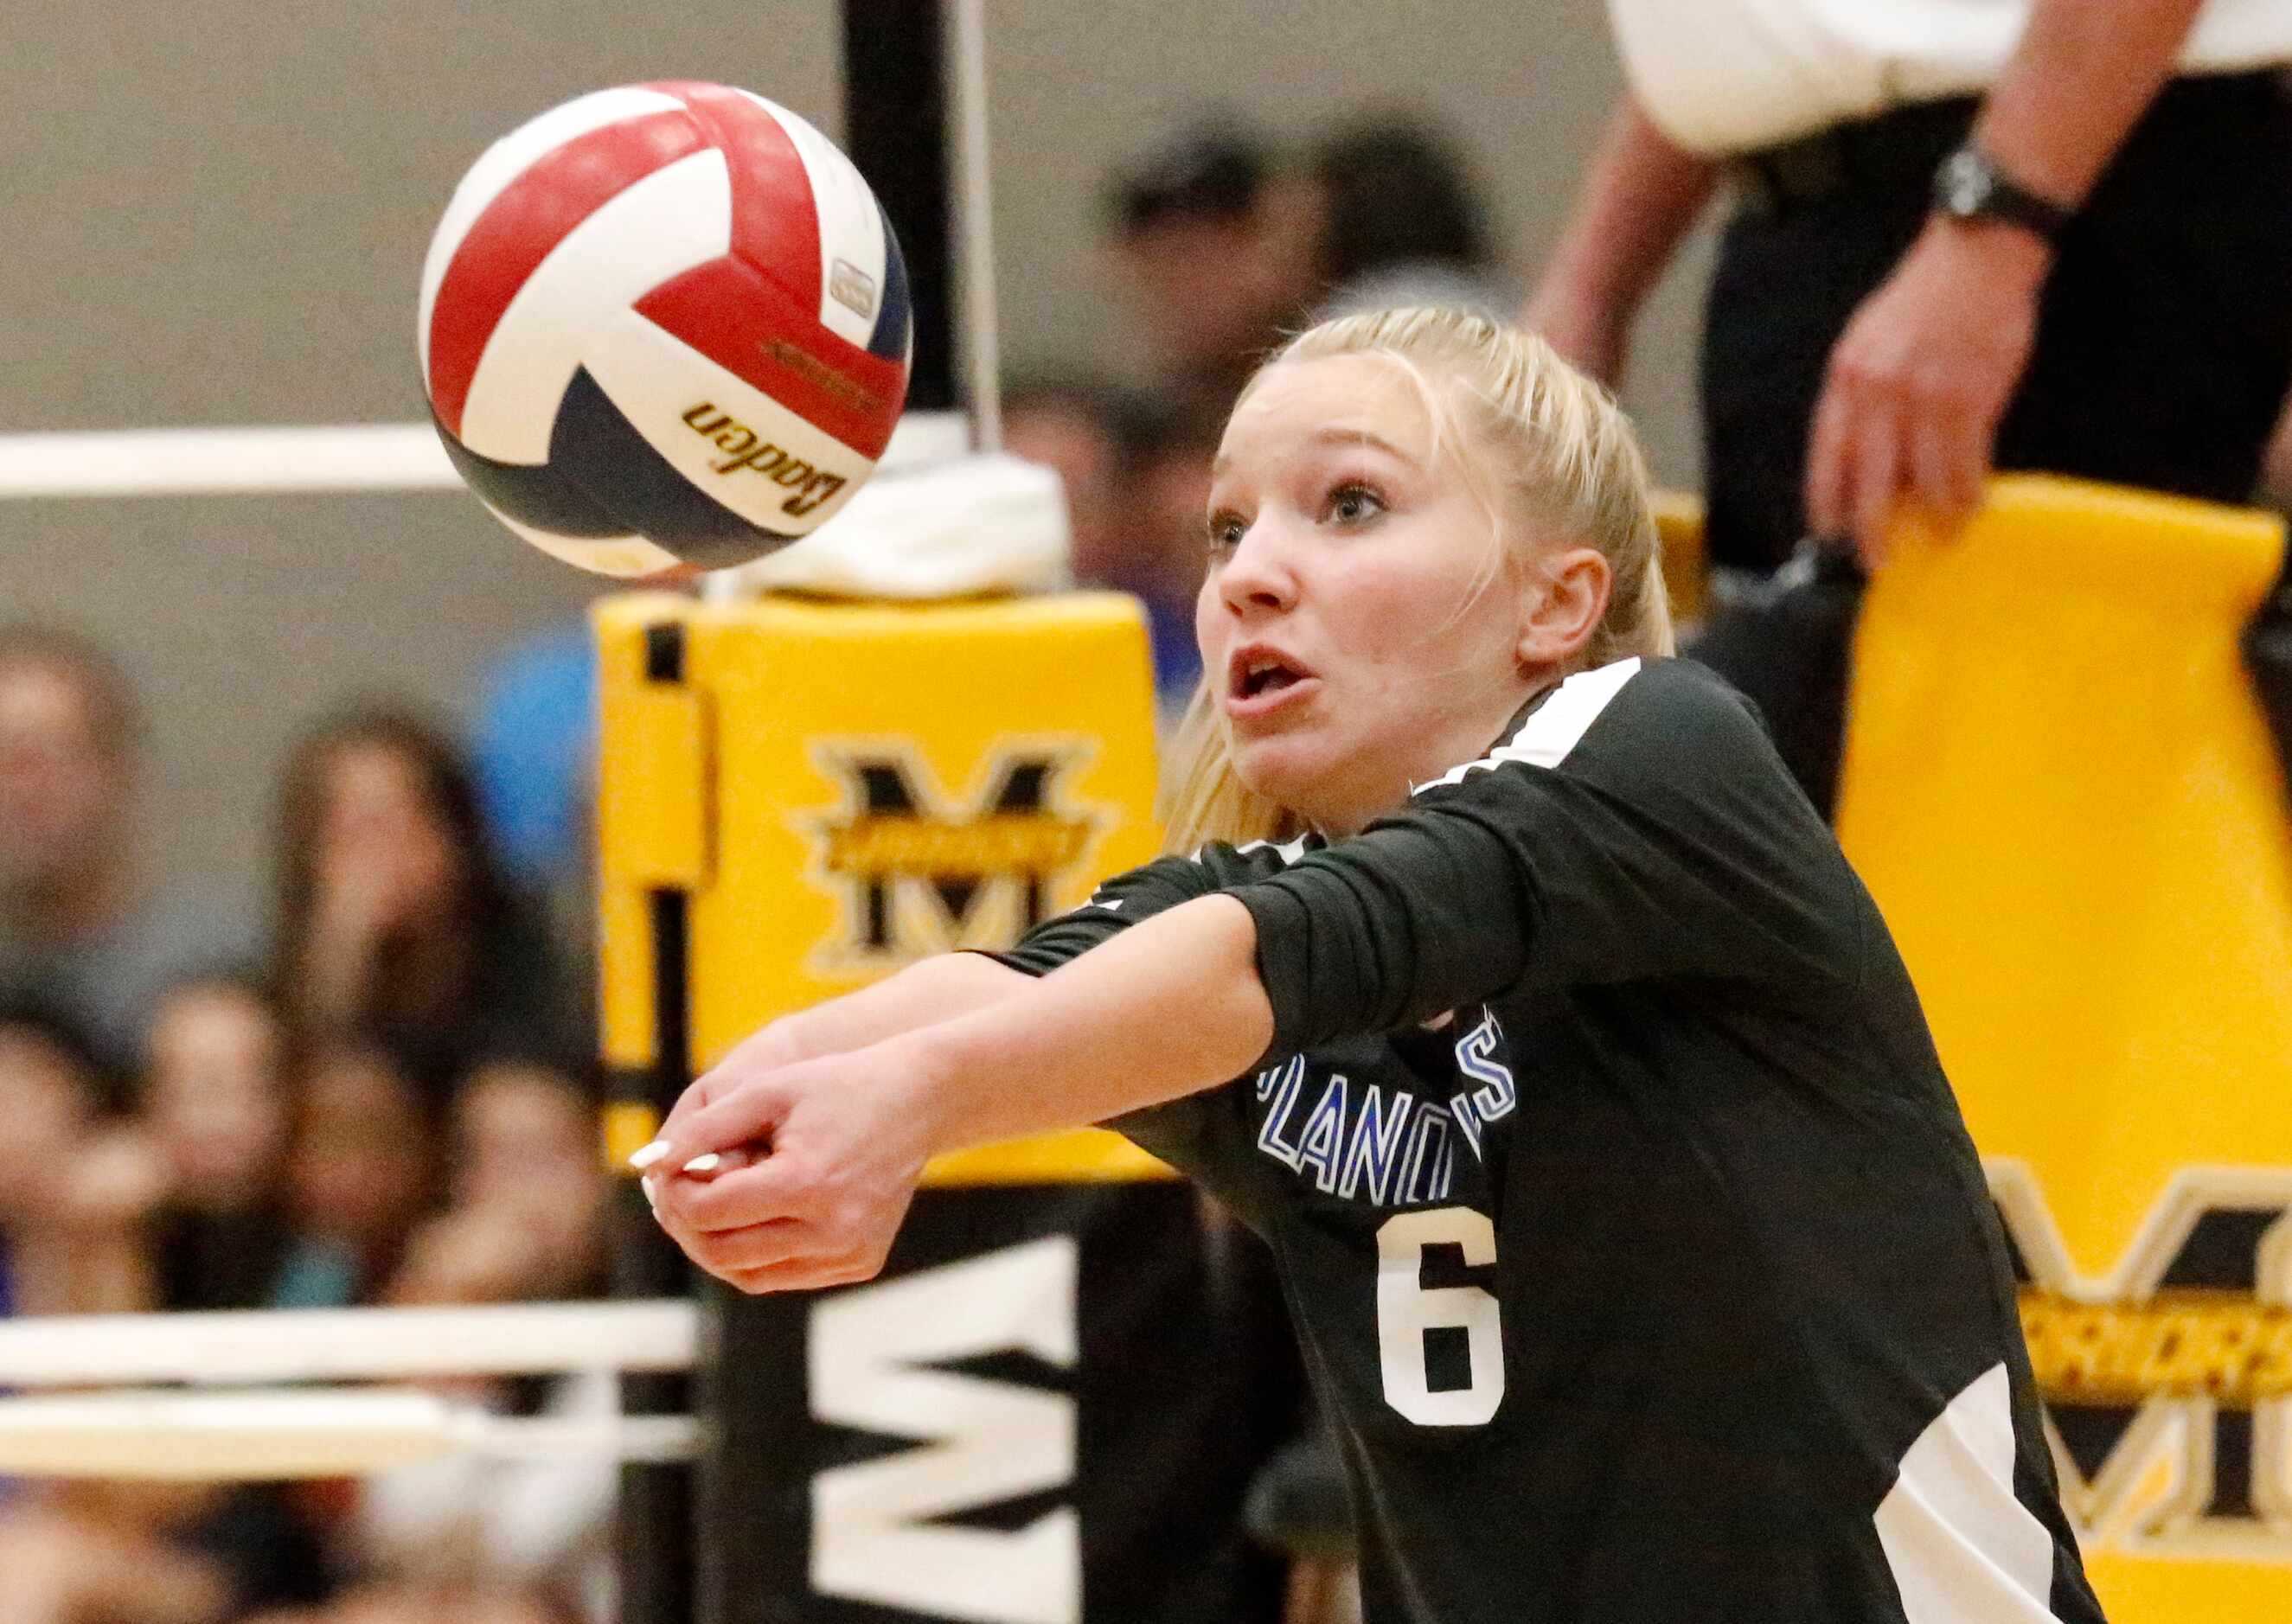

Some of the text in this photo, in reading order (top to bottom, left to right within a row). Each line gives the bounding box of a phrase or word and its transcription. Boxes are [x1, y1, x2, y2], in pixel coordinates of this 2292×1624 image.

[681, 400, 847, 517] Baden
[801, 733, 1105, 980] M
[1377, 1206, 1505, 1426] 6
